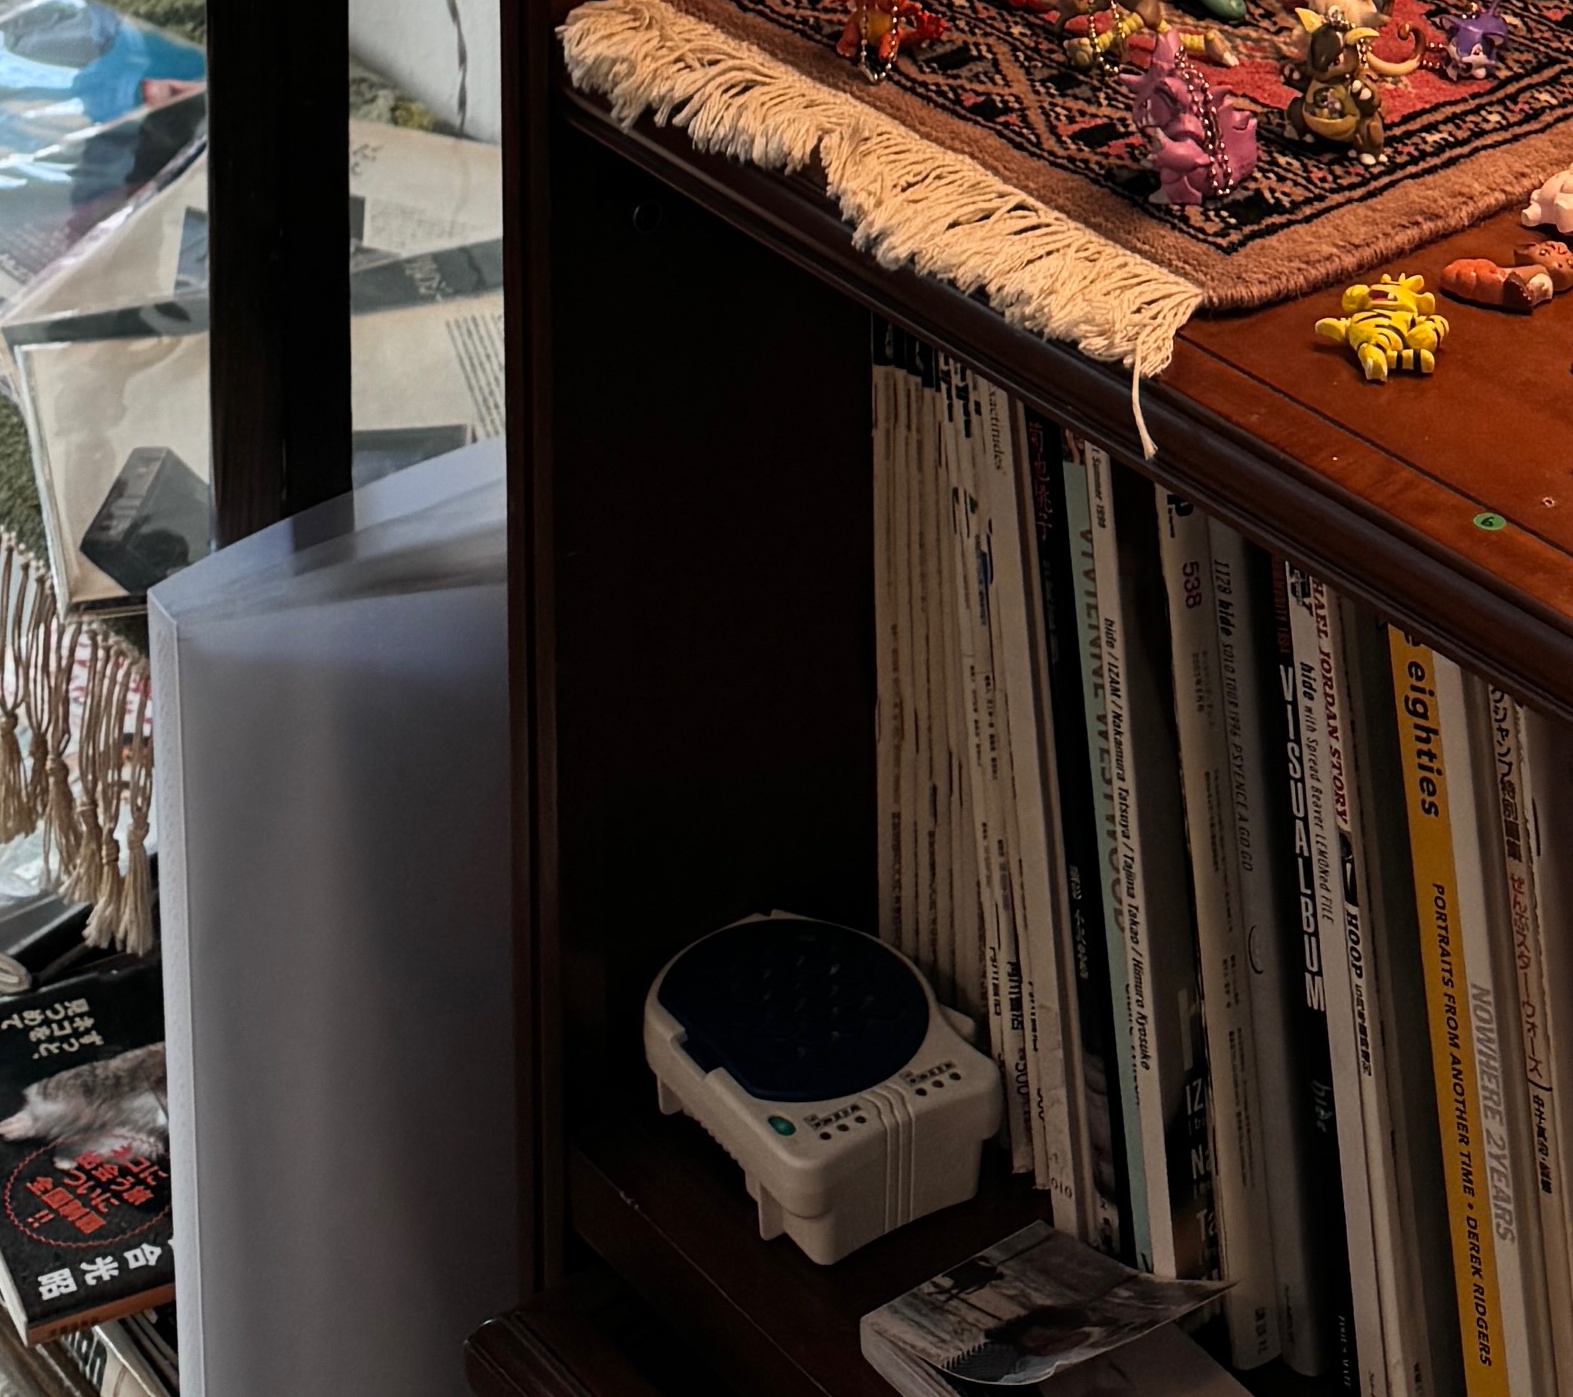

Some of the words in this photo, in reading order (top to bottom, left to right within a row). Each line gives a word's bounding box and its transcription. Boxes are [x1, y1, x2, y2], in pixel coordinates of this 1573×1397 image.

[1182, 560, 1203, 610] 538
[1213, 562, 1231, 595] 1128
[1104, 617, 1116, 649] hide
[1216, 596, 1233, 636] hide
[1107, 663, 1122, 700] IZAM
[1299, 661, 1318, 703] hide
[1319, 645, 1340, 742] JORDAN
[1111, 708, 1127, 782] Nakamura
[1304, 707, 1318, 732] with
[1404, 659, 1444, 818] eighties
[1232, 745, 1249, 815] PSYENCE
[1306, 735, 1322, 782] Spread
[1329, 744, 1349, 825] STORY
[1117, 787, 1132, 842] Tatsuya
[1311, 783, 1325, 831] Beaver
[1123, 855, 1136, 899] Tajima
[1315, 833, 1332, 899] LEMONed
[1128, 903, 1141, 946] Takao
[1321, 899, 1335, 925] FILE
[1432, 881, 1456, 990] PORTRAITS
[1344, 909, 1365, 980] HOOP
[1132, 955, 1147, 1009] Himuro
[1137, 1012, 1153, 1072] Kyosuke
[1441, 993, 1462, 1046] FROM
[1471, 982, 1504, 1125] NOWHERE
[1448, 1050, 1472, 1148] ANOTHER
[1458, 1149, 1476, 1197] TIME
[1484, 1129, 1515, 1246] 2YEARS
[38, 1233, 175, 1301] 合光昭
[1466, 1216, 1485, 1279] DEREK
[1473, 1279, 1493, 1369] RIDGERS
